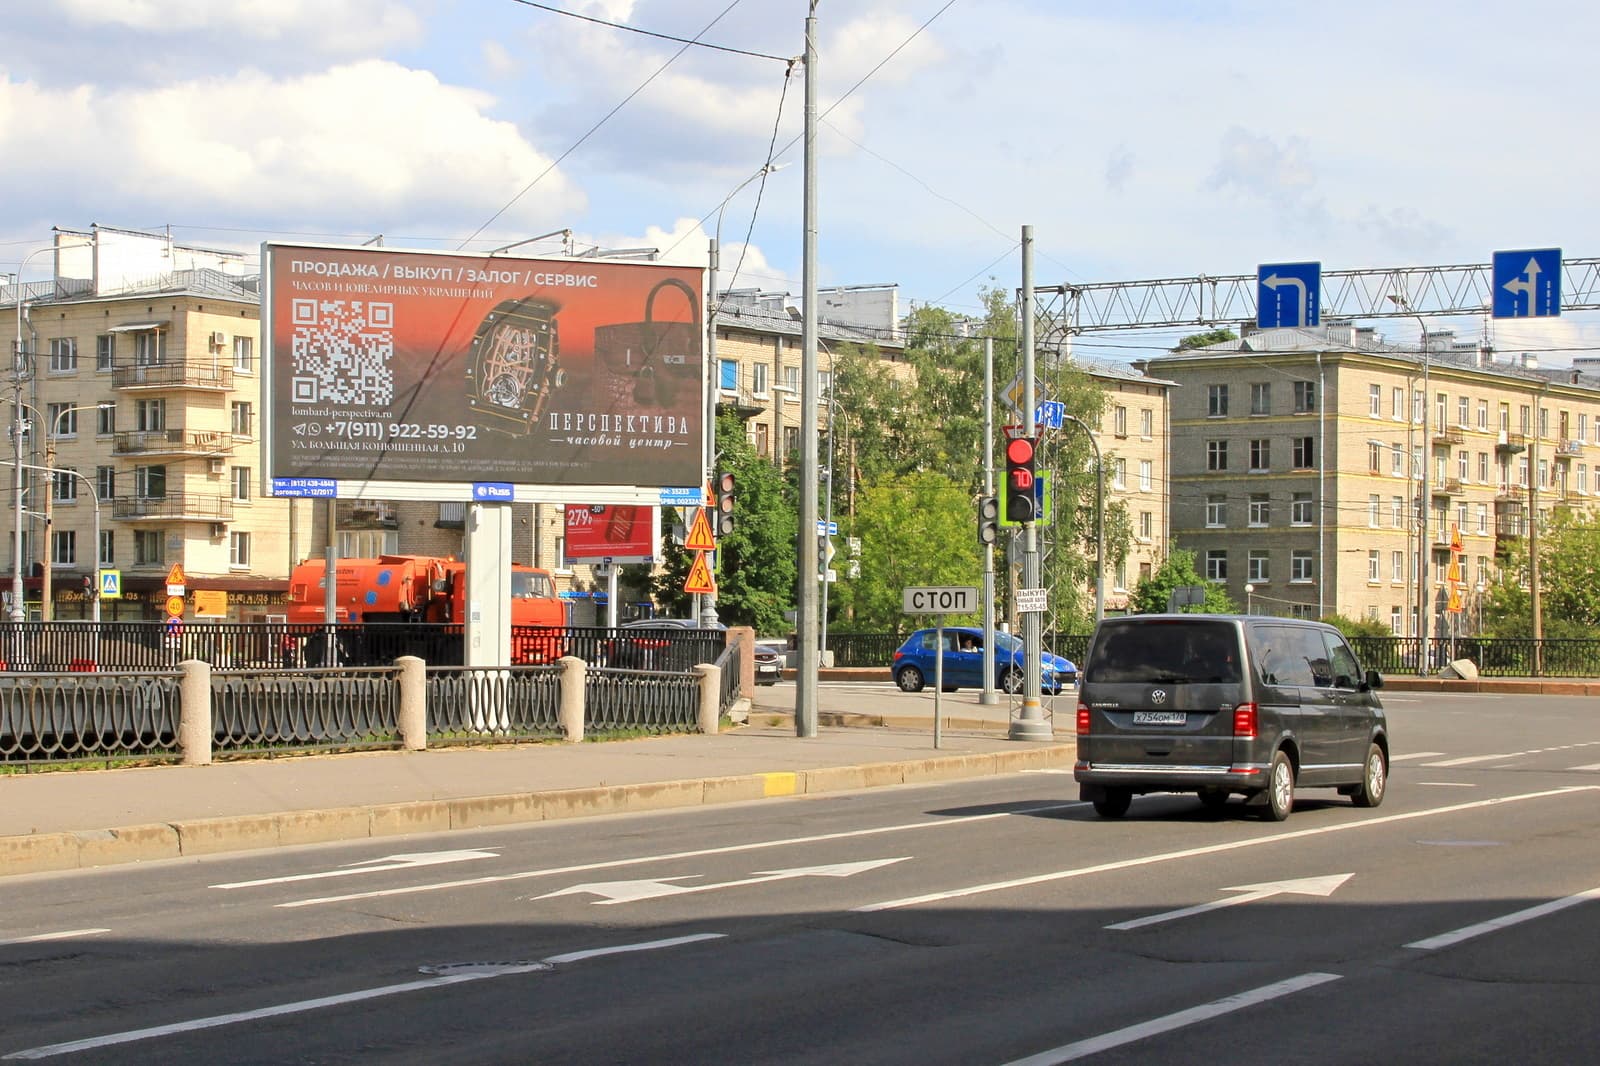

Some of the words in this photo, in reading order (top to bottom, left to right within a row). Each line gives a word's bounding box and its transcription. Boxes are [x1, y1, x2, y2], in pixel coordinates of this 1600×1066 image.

[291, 260, 379, 277] ПРОДАЖА
[394, 265, 453, 280] ВЫКУП
[466, 269, 521, 284] ЗАЛОГ
[534, 273, 598, 288] СЕРВИС
[292, 281, 332, 291] ЧАСОВ
[334, 282, 343, 292] И
[345, 283, 420, 296] ЮВЕЛИРНЫХ
[422, 286, 493, 299] УКРАШЕНИЙ
[291, 407, 393, 419] lombard-perspectiva.ru
[325, 421, 384, 440] +7(911)
[388, 424, 477, 440] 922-59-92
[549, 412, 688, 434] ПЕРСПЕКТИВА
[309, 441, 361, 451] БОЛЬШАЯ
[362, 442, 439, 452] КОНЮШЕННАЯ
[452, 443, 465, 453] 10
[567, 433, 621, 446] часовой
[628, 438, 672, 450] центр
[1013, 471, 1030, 487] 70
[488, 486, 510, 496] Russ
[170, 602, 181, 611] 40
[912, 591, 967, 609] СТОП
